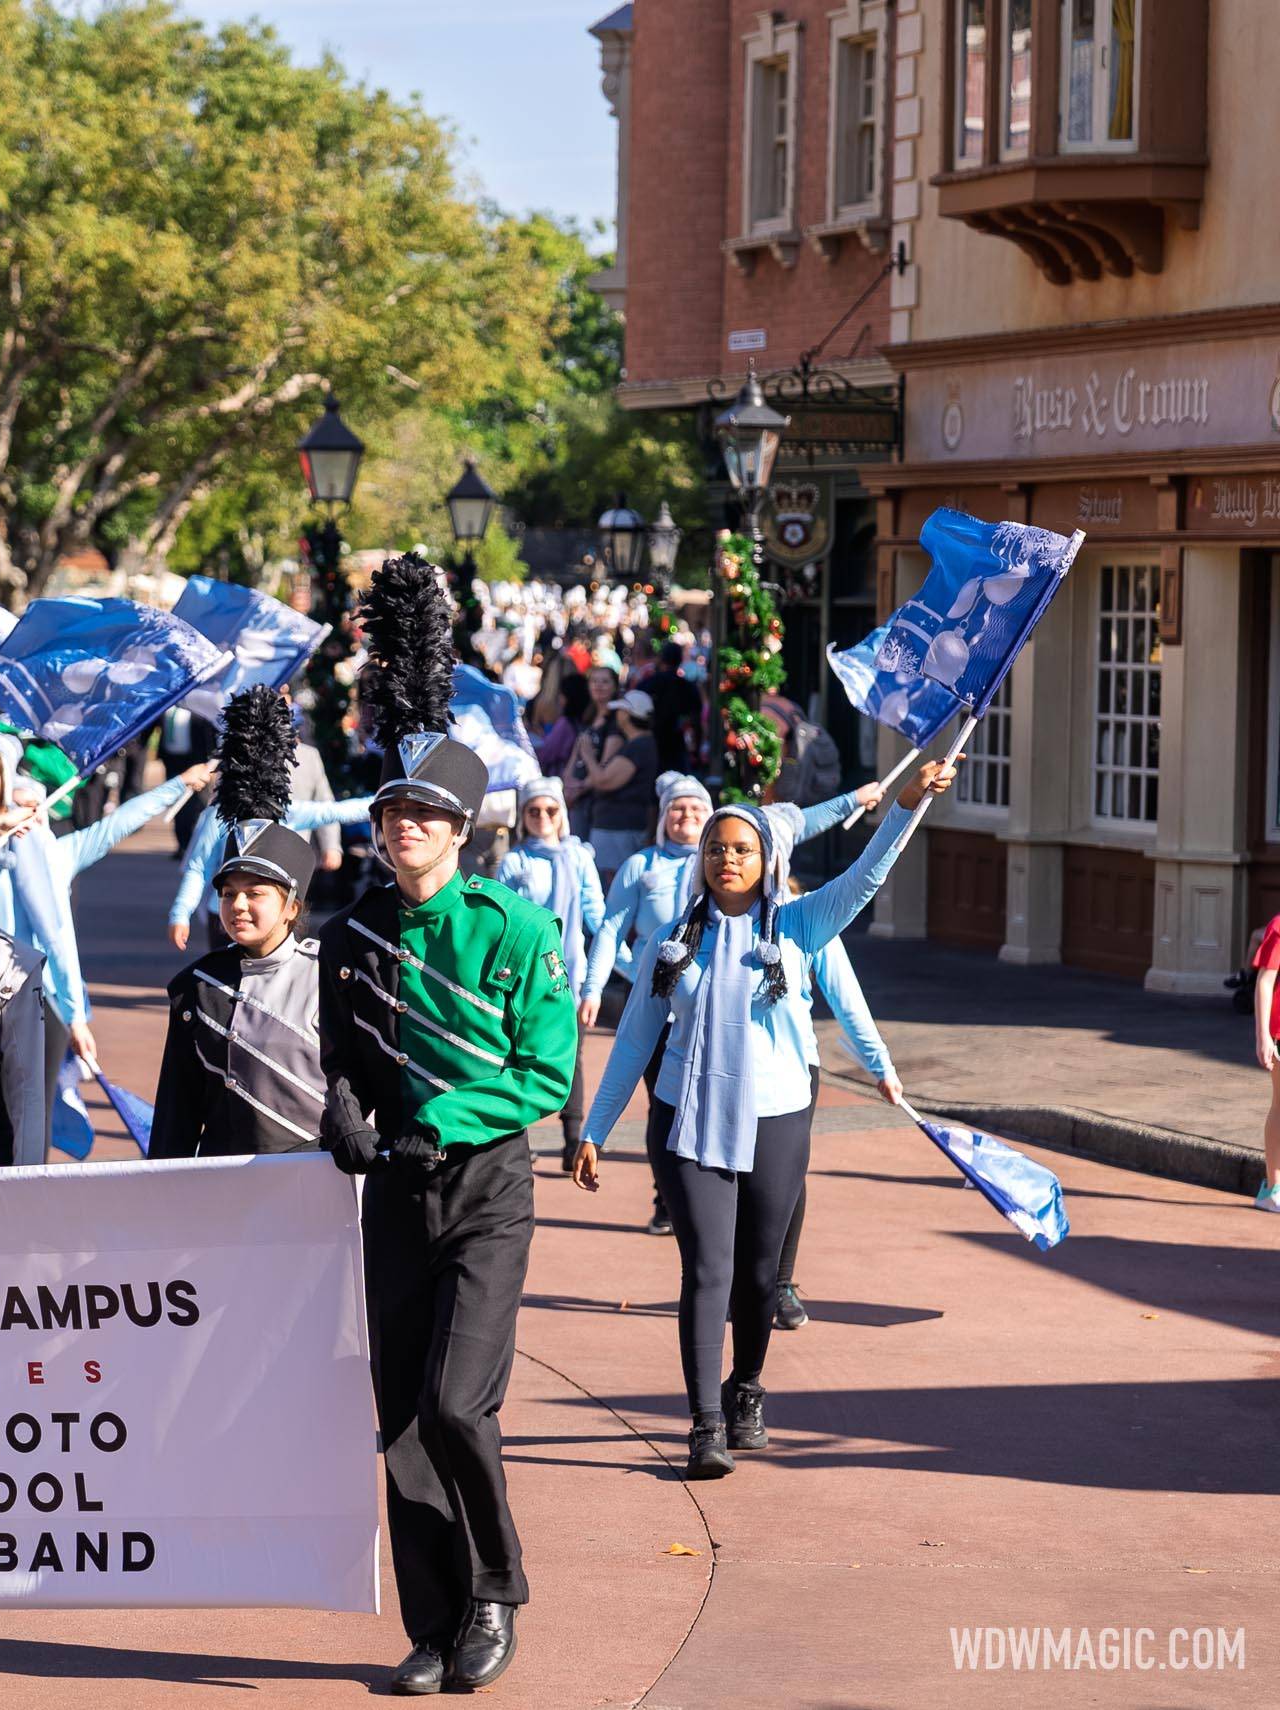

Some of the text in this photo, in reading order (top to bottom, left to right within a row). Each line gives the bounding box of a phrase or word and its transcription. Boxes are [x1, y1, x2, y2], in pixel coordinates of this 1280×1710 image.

[1015, 367, 1208, 440] Rose & Crown
